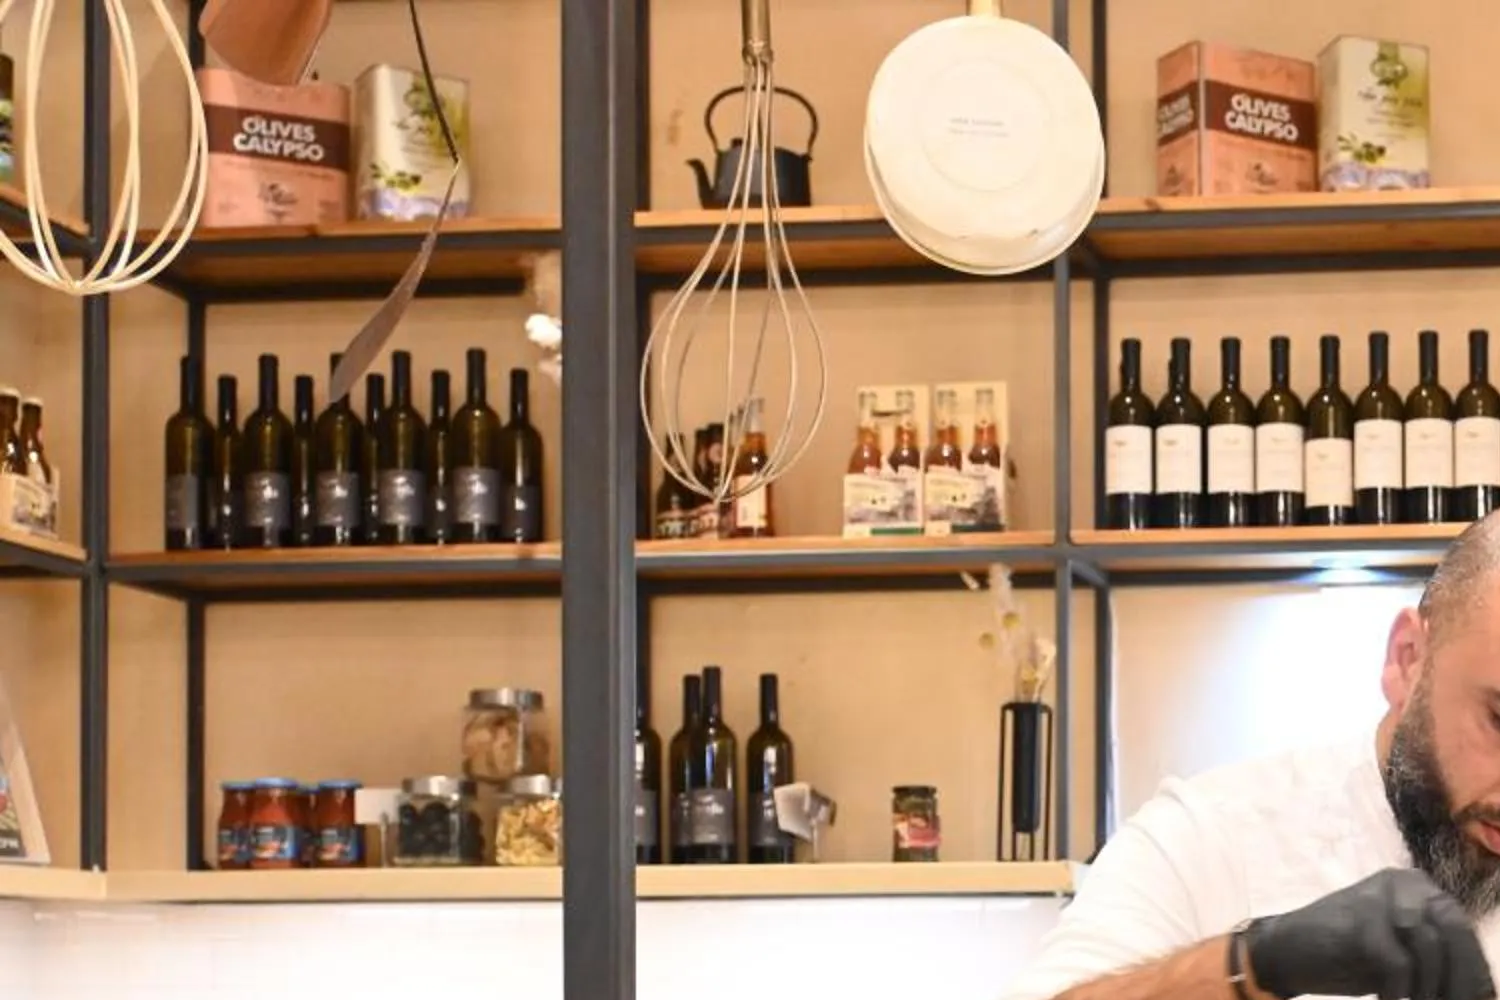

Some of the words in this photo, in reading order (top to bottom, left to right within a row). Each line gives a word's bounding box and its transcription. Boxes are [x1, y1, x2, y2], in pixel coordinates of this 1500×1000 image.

[1231, 93, 1291, 123] OLIVES
[242, 115, 316, 144] OLIVES
[1224, 111, 1298, 142] CALYPSO
[233, 132, 325, 162] CALYPSO
